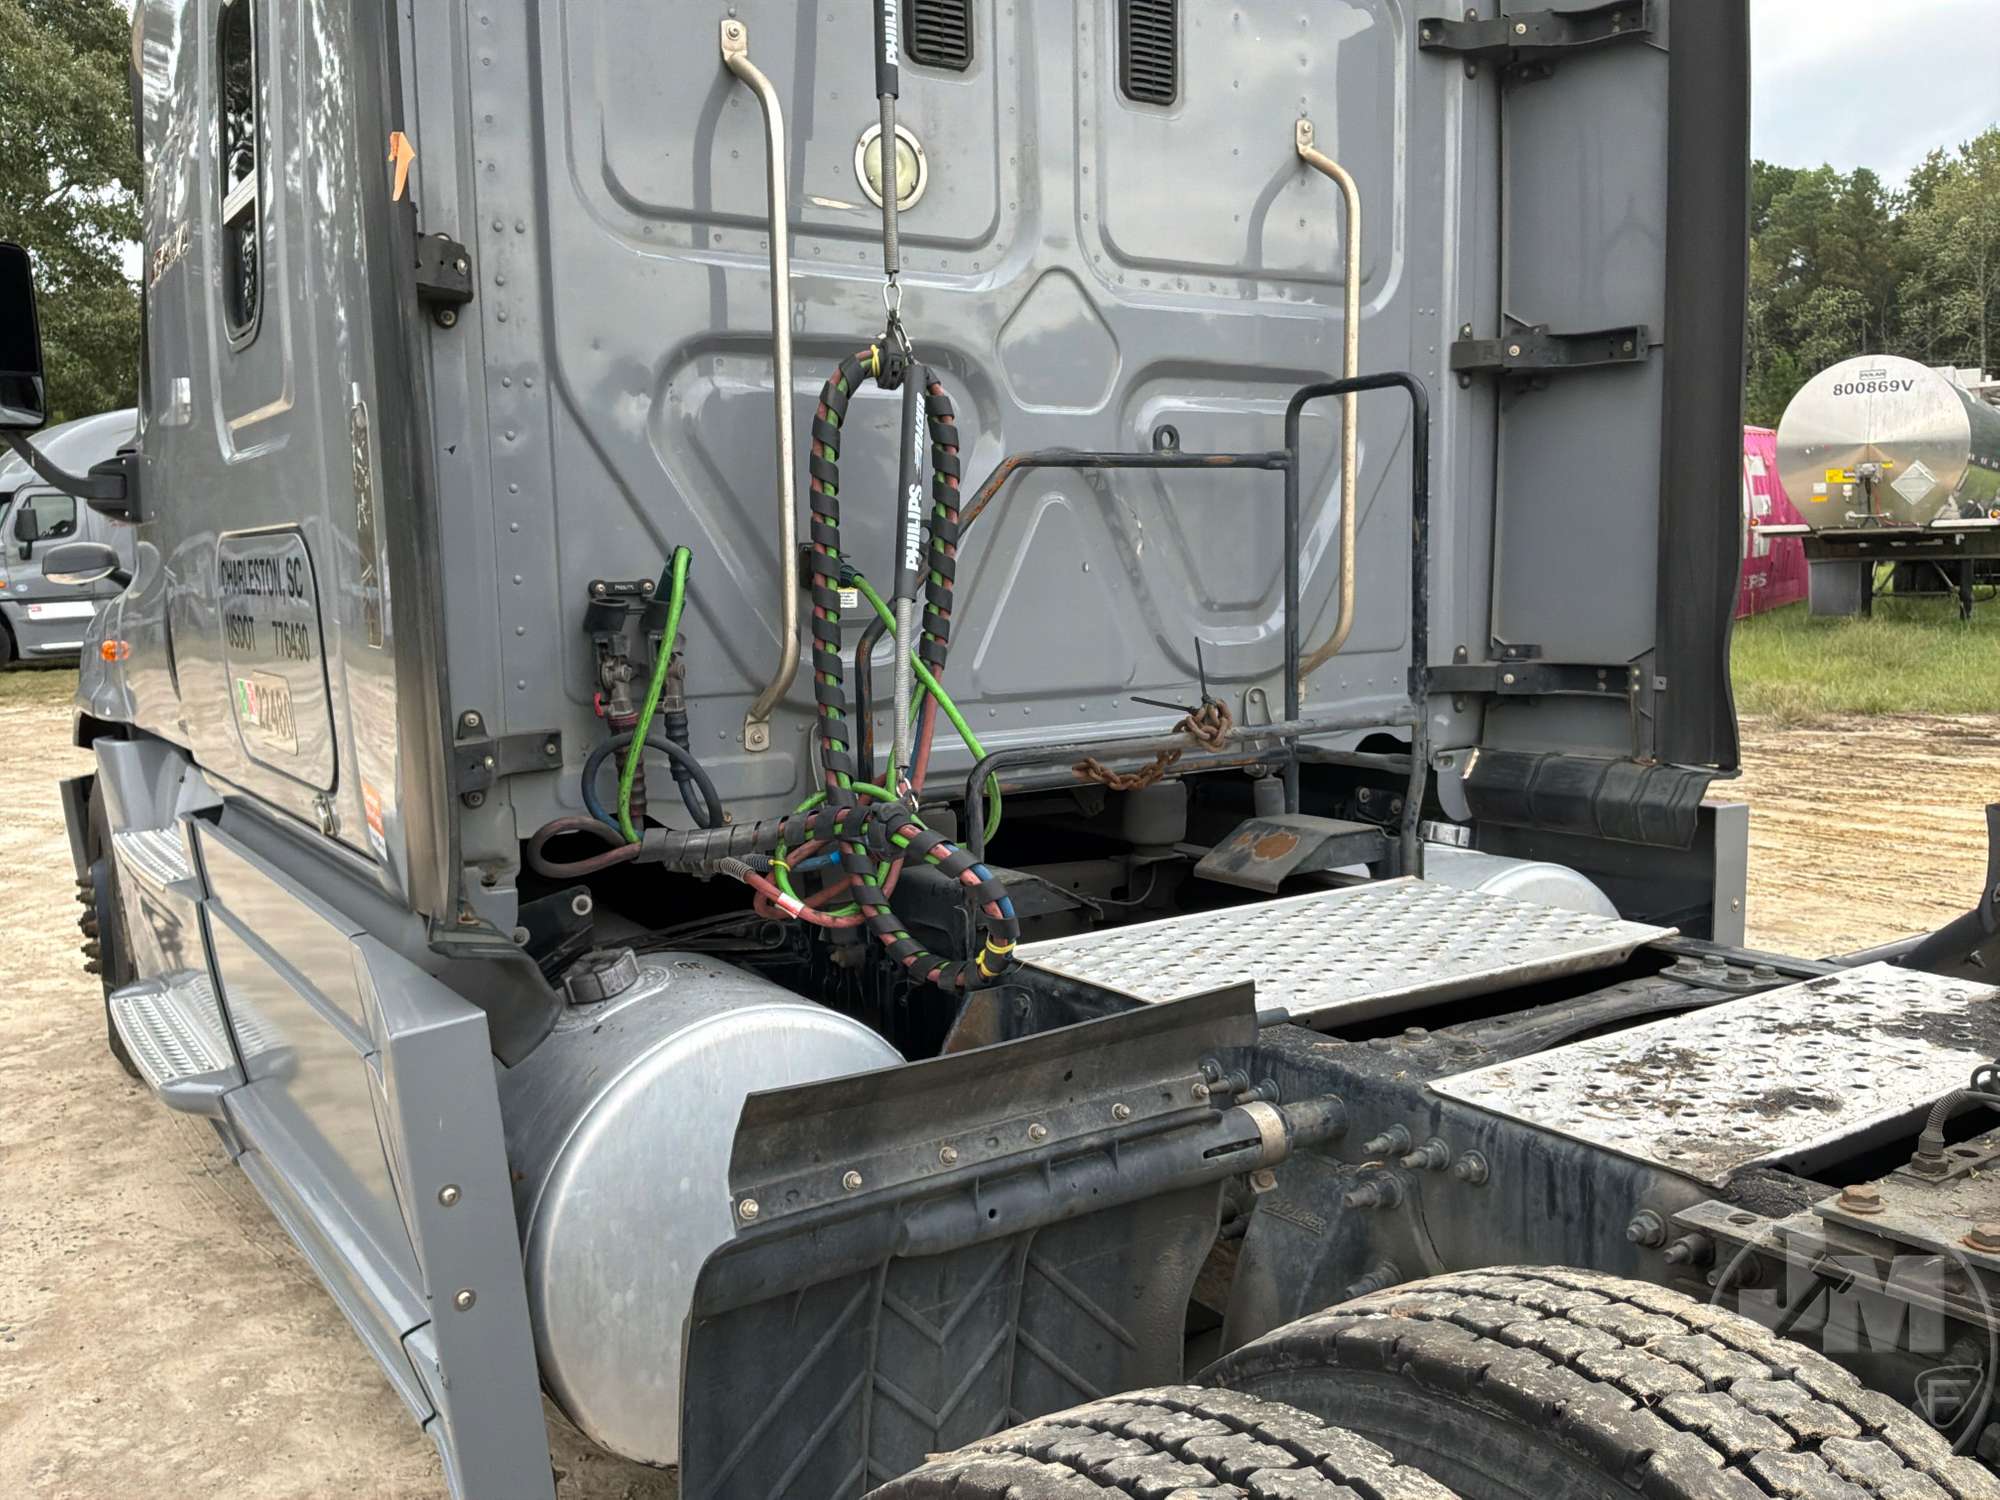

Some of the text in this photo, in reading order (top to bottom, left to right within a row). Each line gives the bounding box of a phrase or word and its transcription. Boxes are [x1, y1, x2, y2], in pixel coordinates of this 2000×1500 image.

[1833, 380, 1914, 396] 800869V
[905, 484, 922, 571] PHILLIPS
[221, 557, 303, 605] CHARLESTON, SC
[226, 611, 311, 662] USDOT 776430
